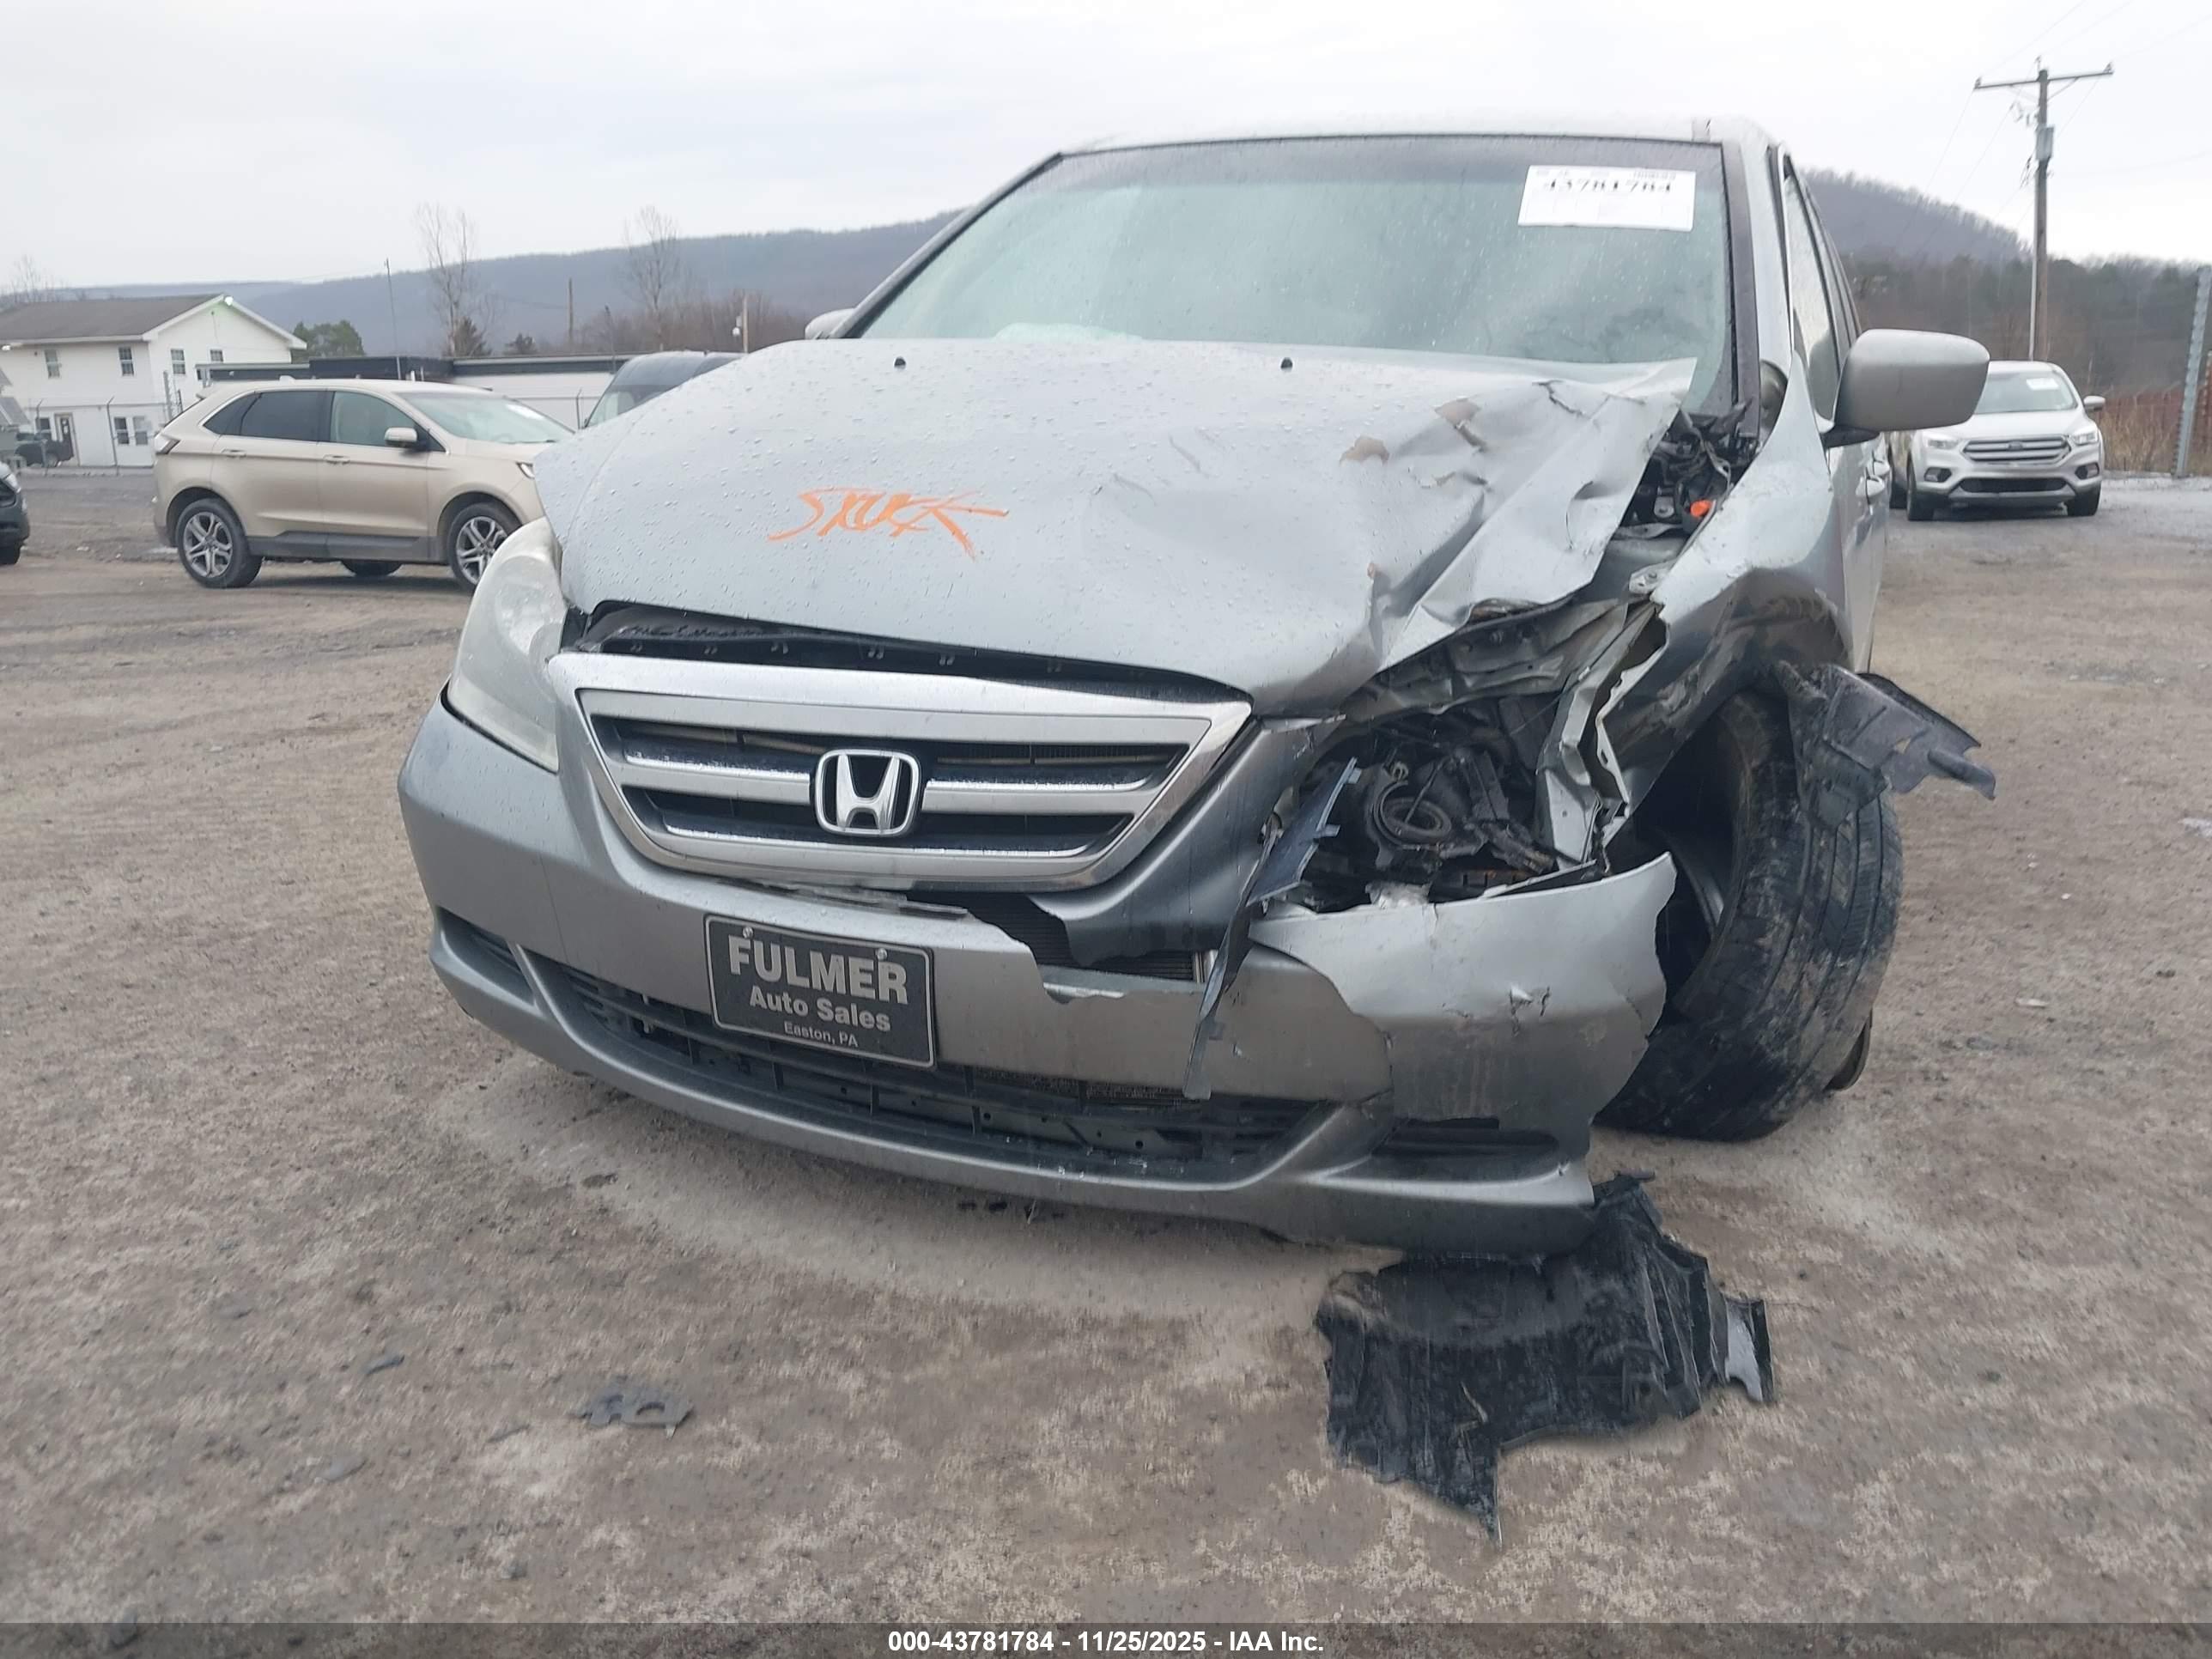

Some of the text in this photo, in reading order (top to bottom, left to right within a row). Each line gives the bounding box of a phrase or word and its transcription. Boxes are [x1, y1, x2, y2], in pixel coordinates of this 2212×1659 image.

[727, 934, 908, 1005] FULMER
[749, 985, 891, 1031] Auto Sales
[784, 1020, 859, 1048] Easton, PA
